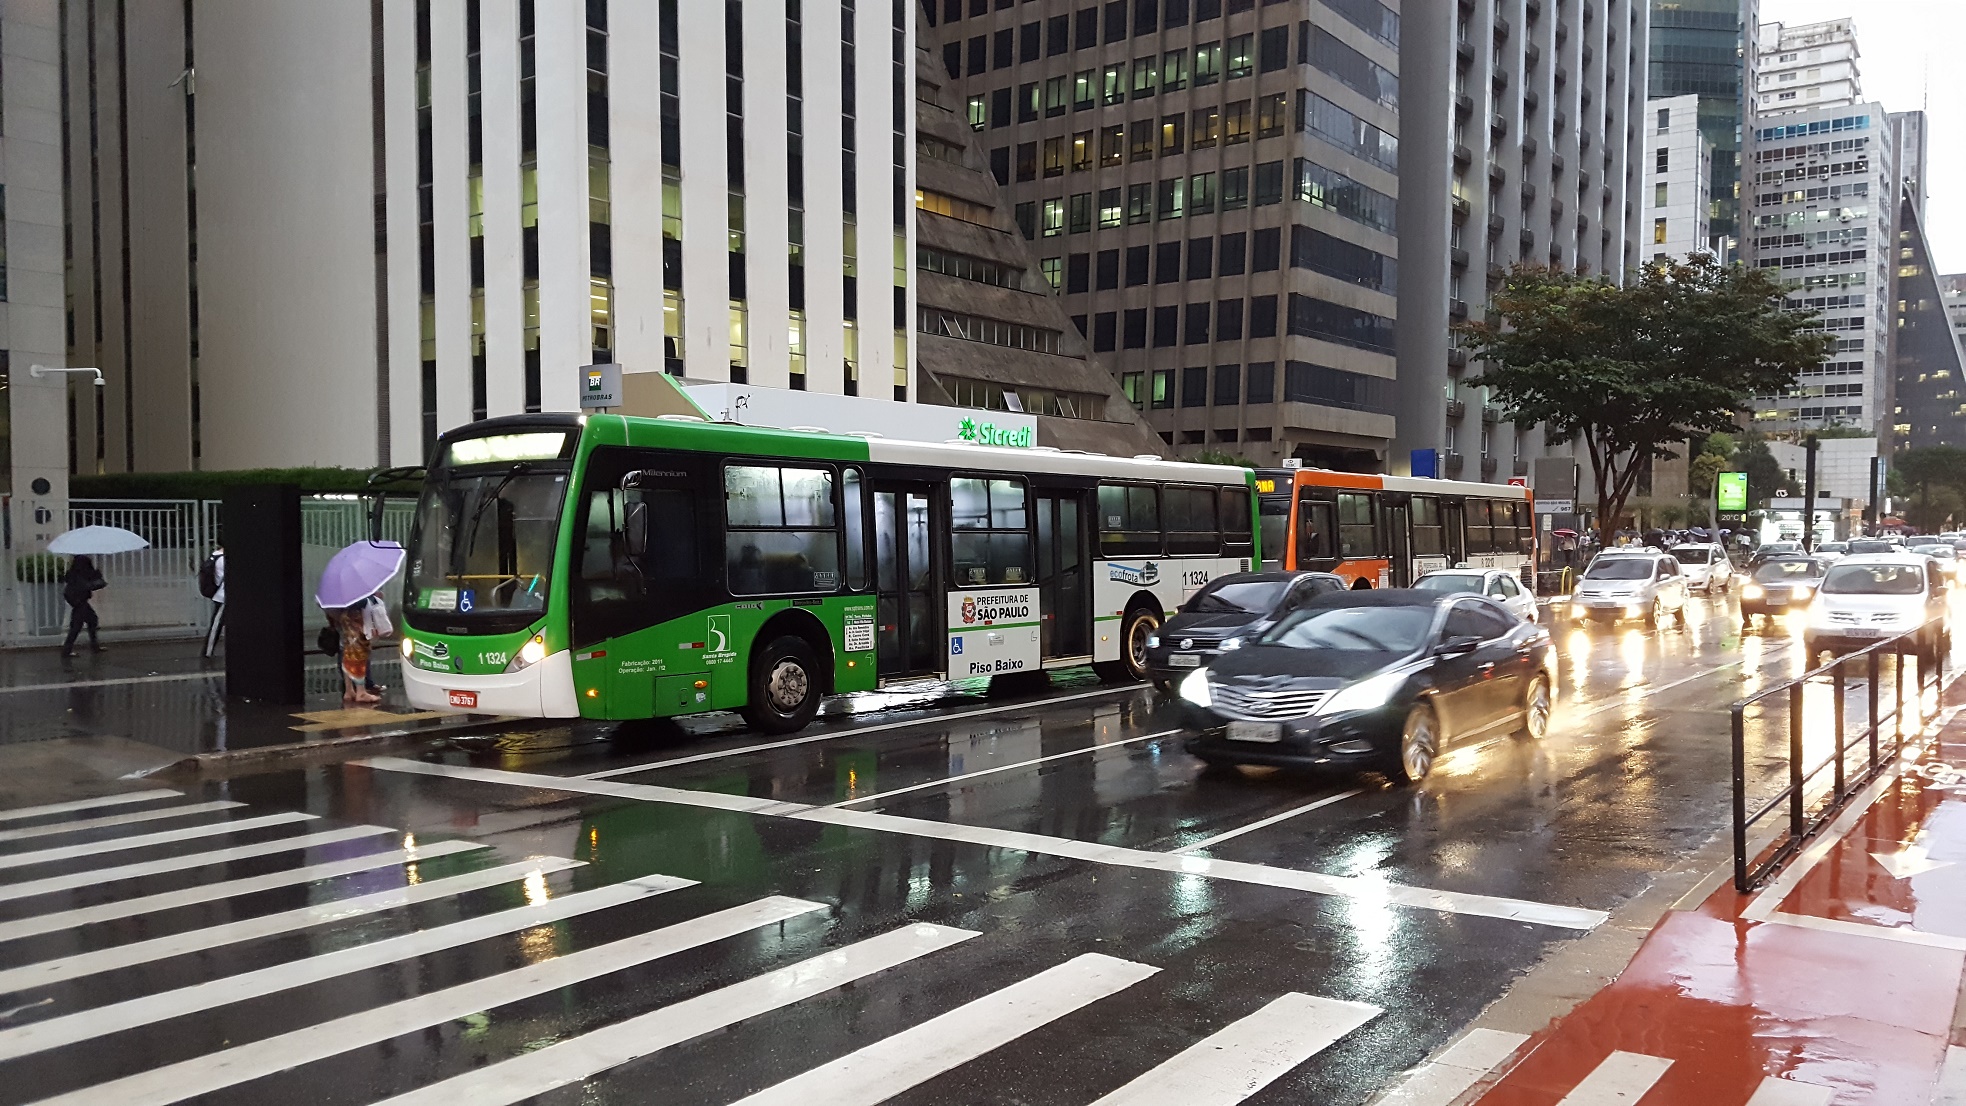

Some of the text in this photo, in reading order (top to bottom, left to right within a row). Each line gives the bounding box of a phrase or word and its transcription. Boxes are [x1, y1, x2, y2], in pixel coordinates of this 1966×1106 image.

[589, 377, 600, 387] BR
[979, 422, 1032, 448] Sicredi
[642, 469, 687, 477] Millennium
[1110, 569, 1139, 583] ecofrota
[1183, 571, 1209, 586] 1 1324
[976, 594, 1029, 606] PREFEITURA DE
[977, 605, 1029, 621] SÃO PAULO
[420, 658, 450, 671] Piso Baixo
[478, 652, 508, 665] 1 1324
[969, 658, 1024, 675] Piso Baixo
